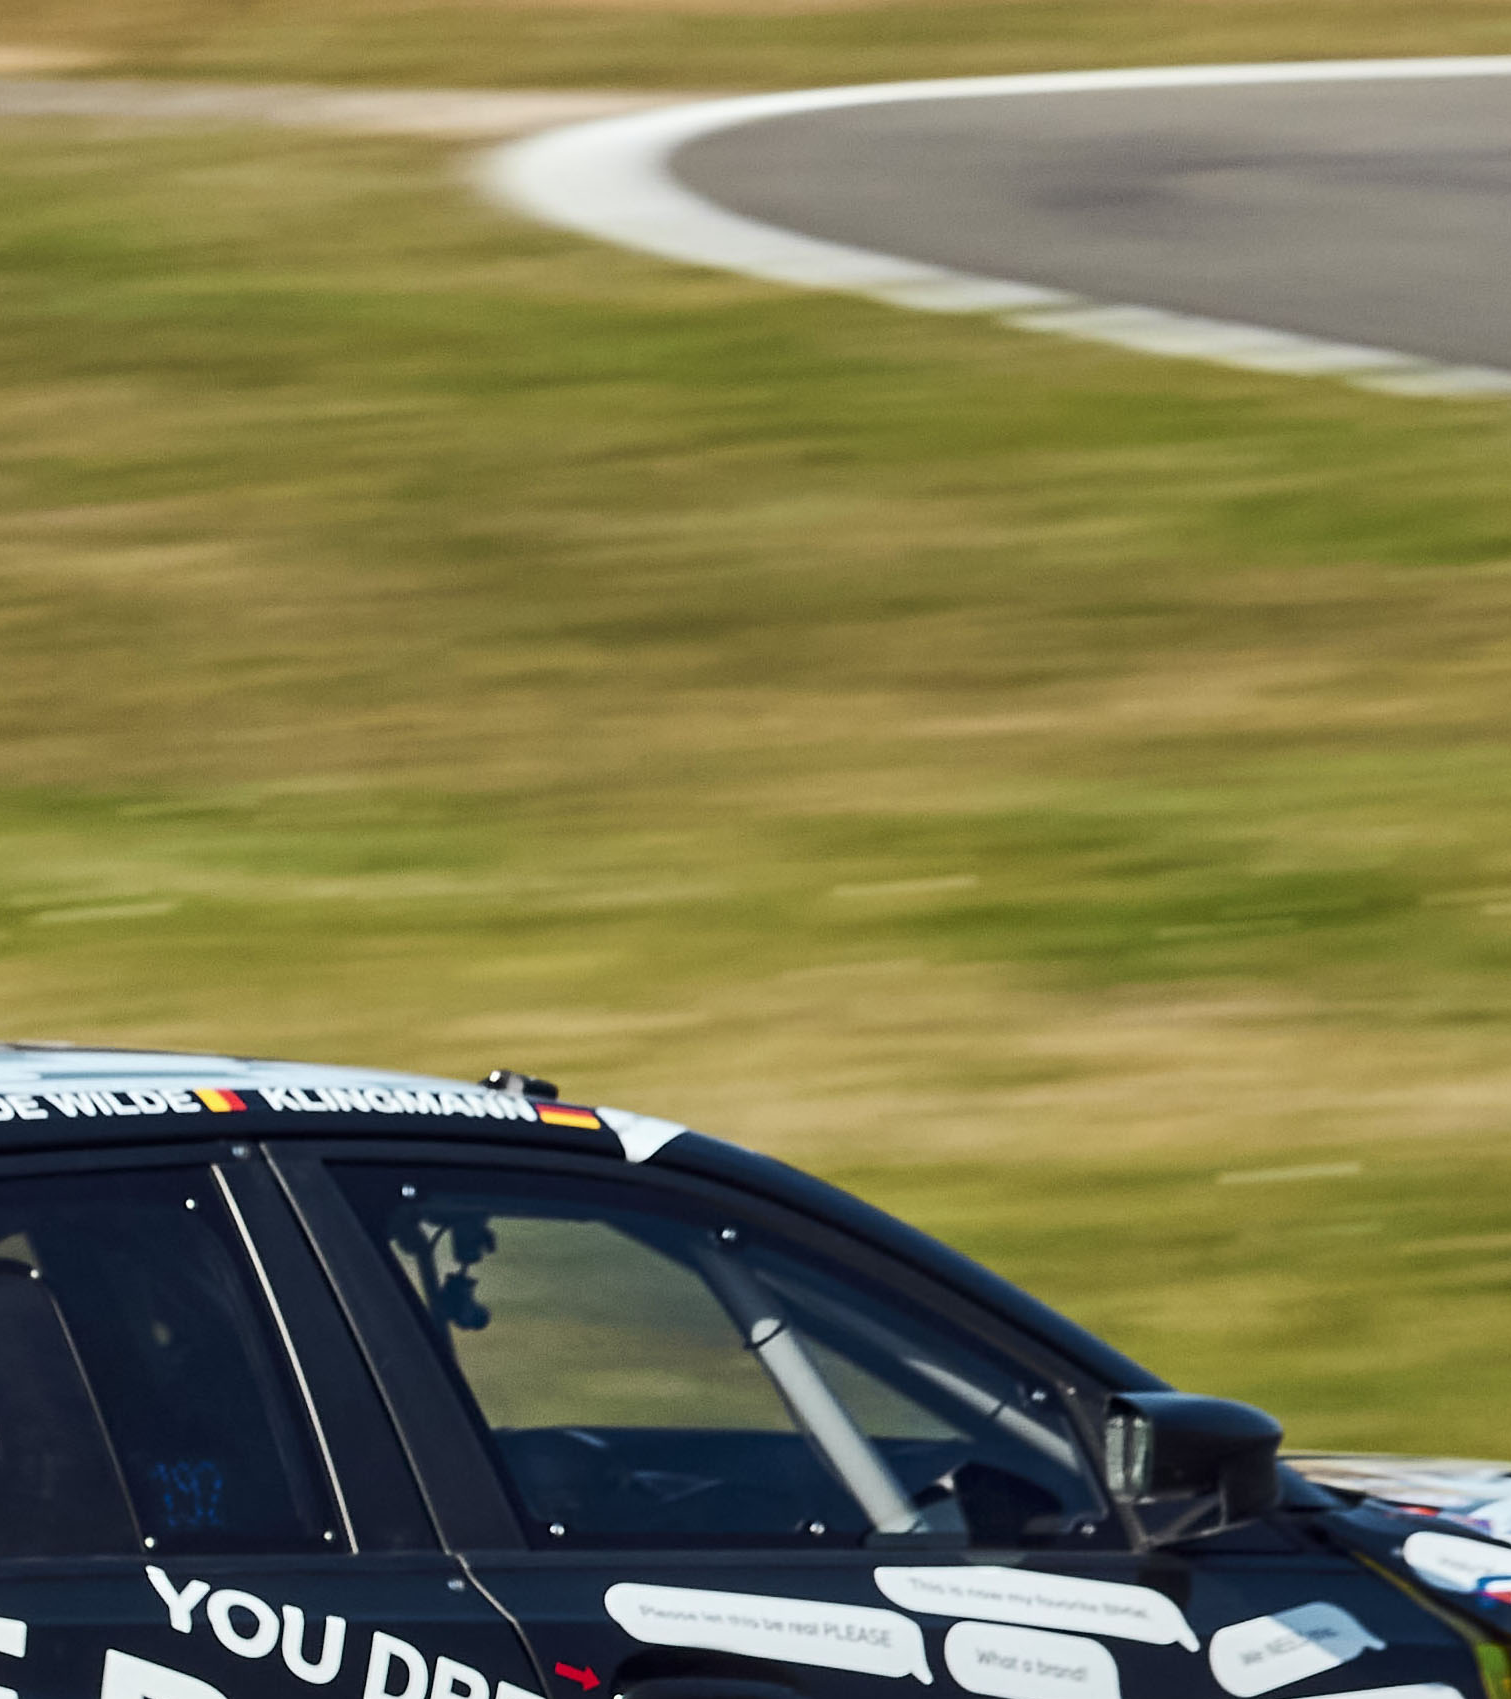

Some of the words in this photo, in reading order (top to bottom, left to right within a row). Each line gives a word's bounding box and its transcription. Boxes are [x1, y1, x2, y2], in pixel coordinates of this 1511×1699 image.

[47, 1088, 202, 1120] WILDE
[257, 1087, 539, 1123] KLINGMANN
[145, 1566, 350, 1686] YOU
[764, 1616, 785, 1633] be
[788, 1620, 819, 1637] real
[823, 1621, 893, 1649] PLEASE
[976, 1648, 1016, 1670] What
[1023, 1660, 1034, 1673] a
